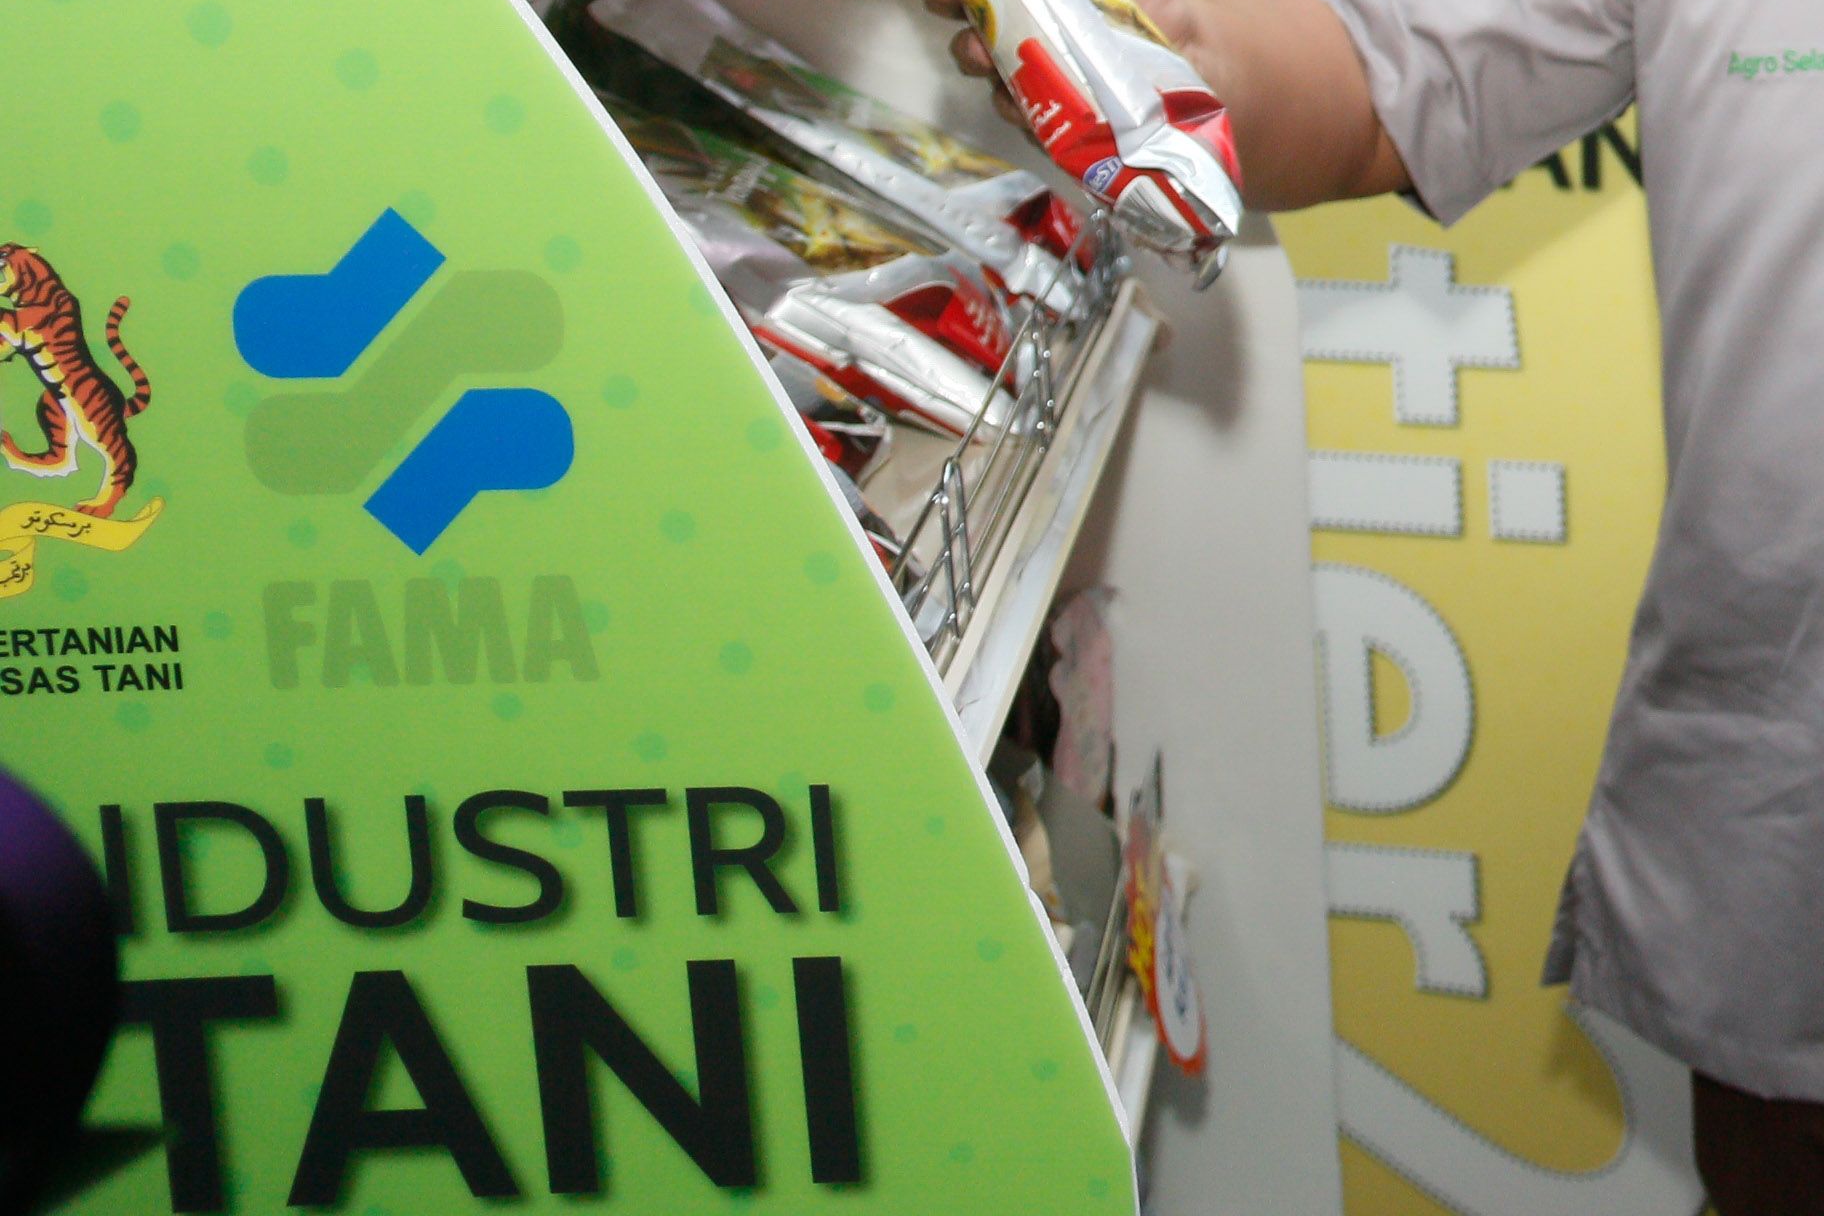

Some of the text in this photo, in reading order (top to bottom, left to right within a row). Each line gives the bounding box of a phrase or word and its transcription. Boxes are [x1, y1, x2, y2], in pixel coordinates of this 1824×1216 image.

[1727, 50, 1778, 80] Agro
[262, 572, 603, 692] FAMA
[93, 662, 184, 693] TANI
[116, 954, 864, 1215] TANI
